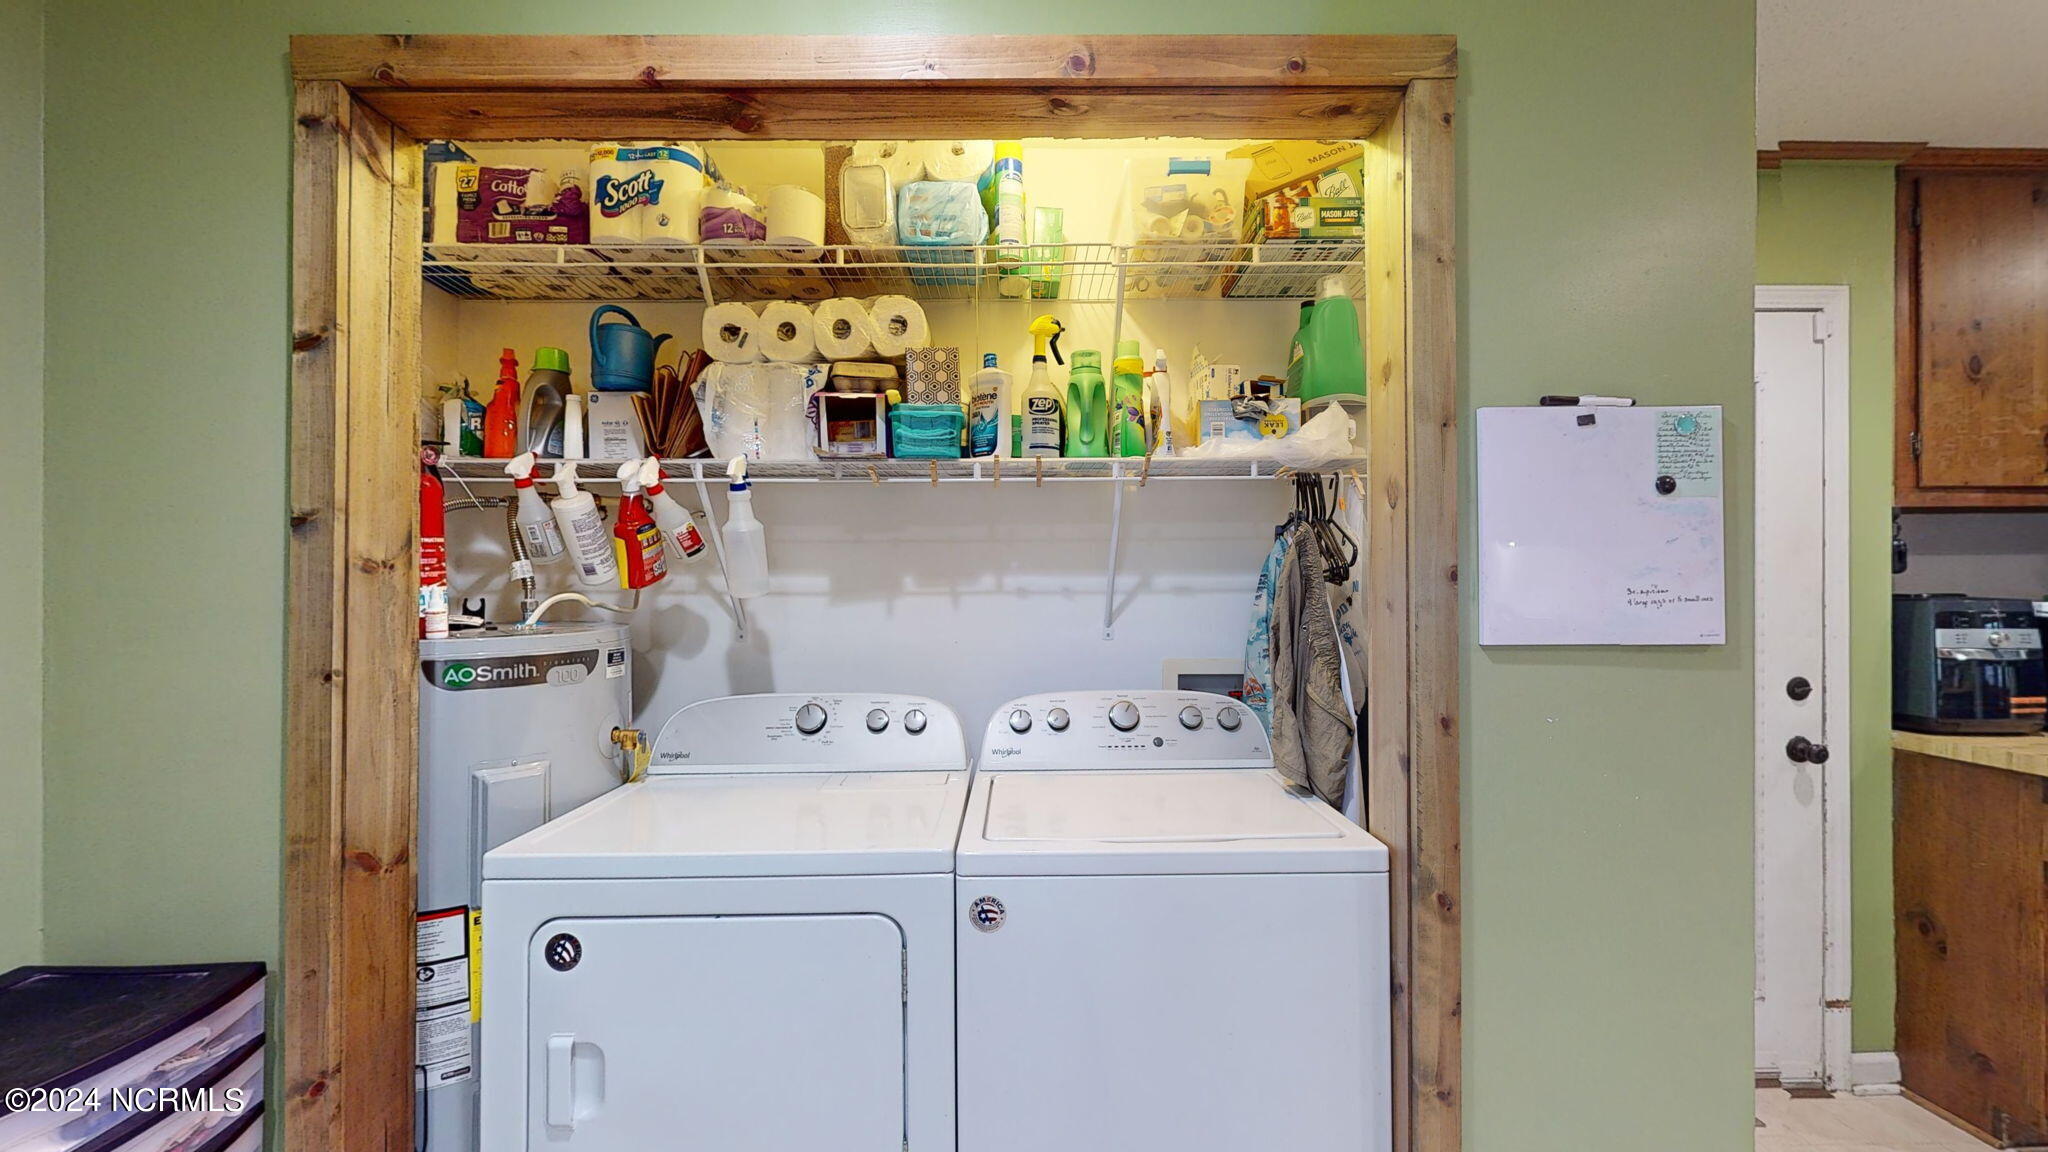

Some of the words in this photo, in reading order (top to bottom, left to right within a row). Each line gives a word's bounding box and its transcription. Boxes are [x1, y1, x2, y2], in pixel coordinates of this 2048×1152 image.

[1307, 145, 1346, 165] MASON
[460, 176, 475, 188] 27
[604, 170, 653, 207] Scott
[1321, 210, 1342, 218] MASON
[1344, 210, 1359, 218] JARS
[723, 223, 734, 234] 12
[555, 669, 579, 683] 100
[660, 751, 690, 761] Whirlpool
[992, 748, 1021, 758] Whirlpool
